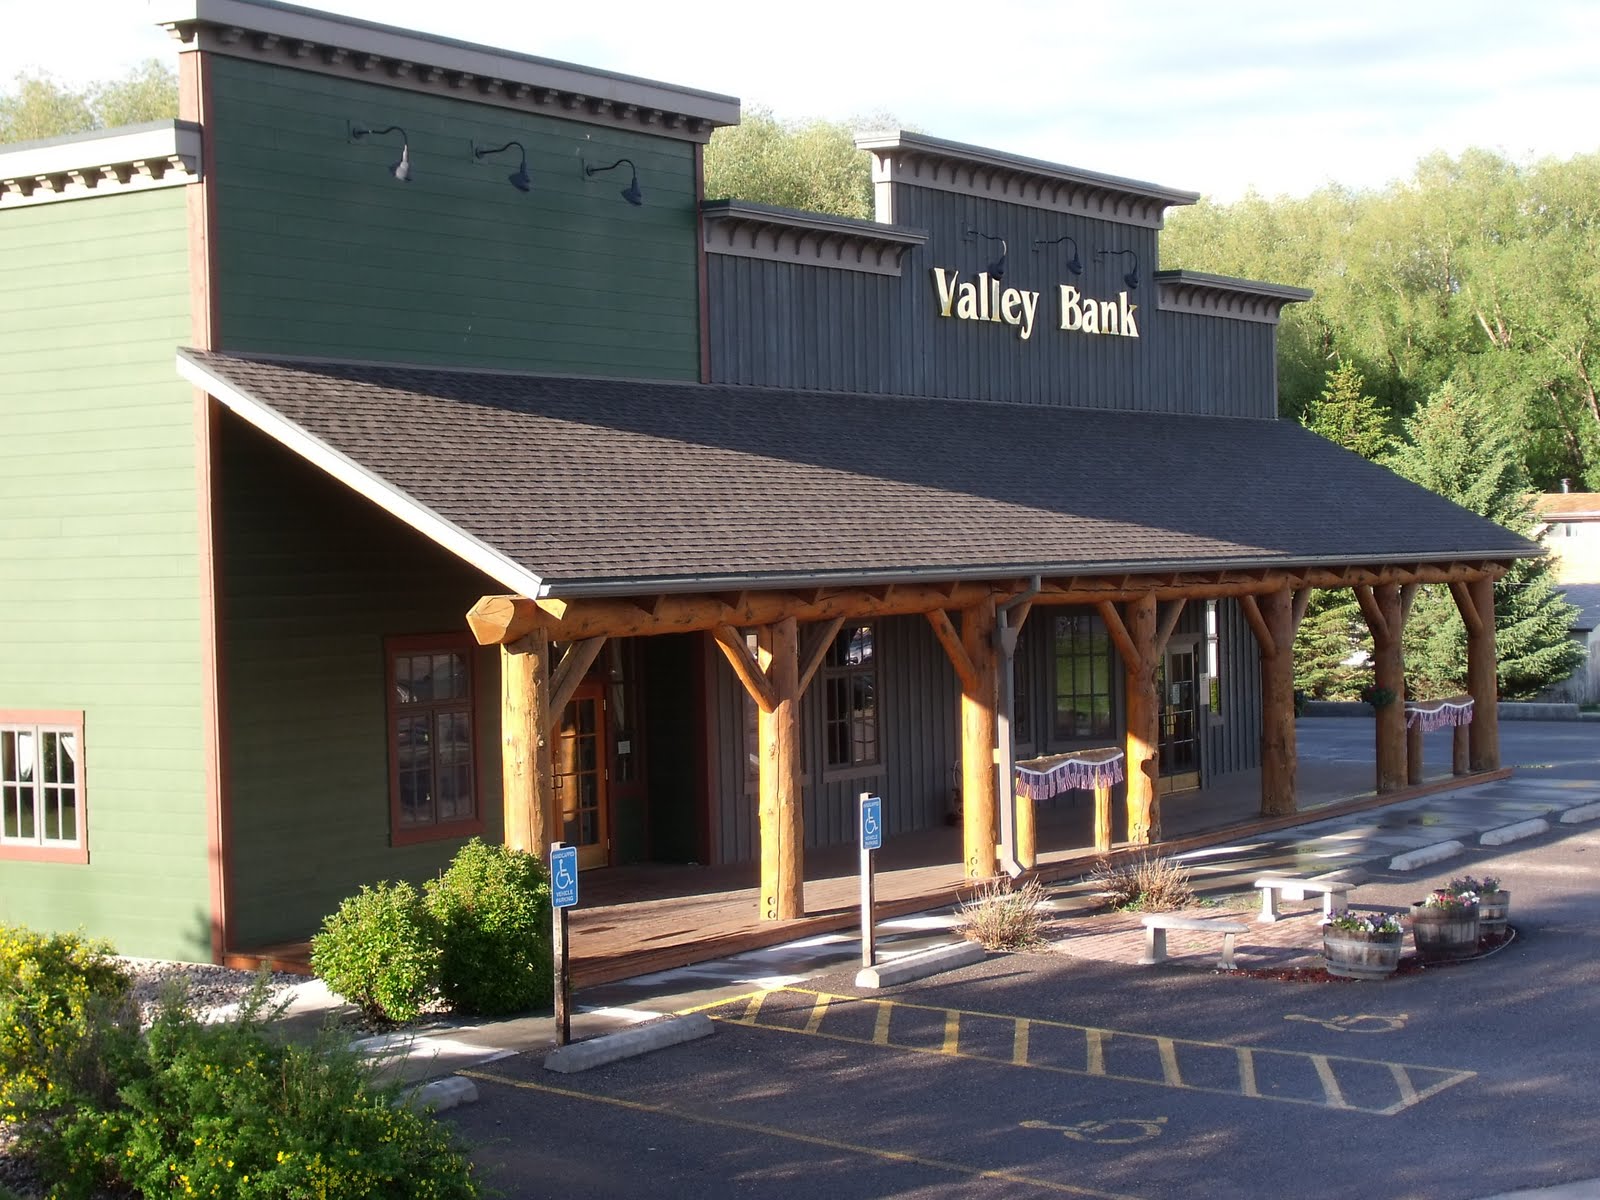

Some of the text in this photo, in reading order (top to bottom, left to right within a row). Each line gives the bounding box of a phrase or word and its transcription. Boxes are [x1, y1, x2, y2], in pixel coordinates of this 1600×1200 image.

[932, 267, 1139, 340] Valley Bank
[556, 889, 573, 897] VEHICLE
